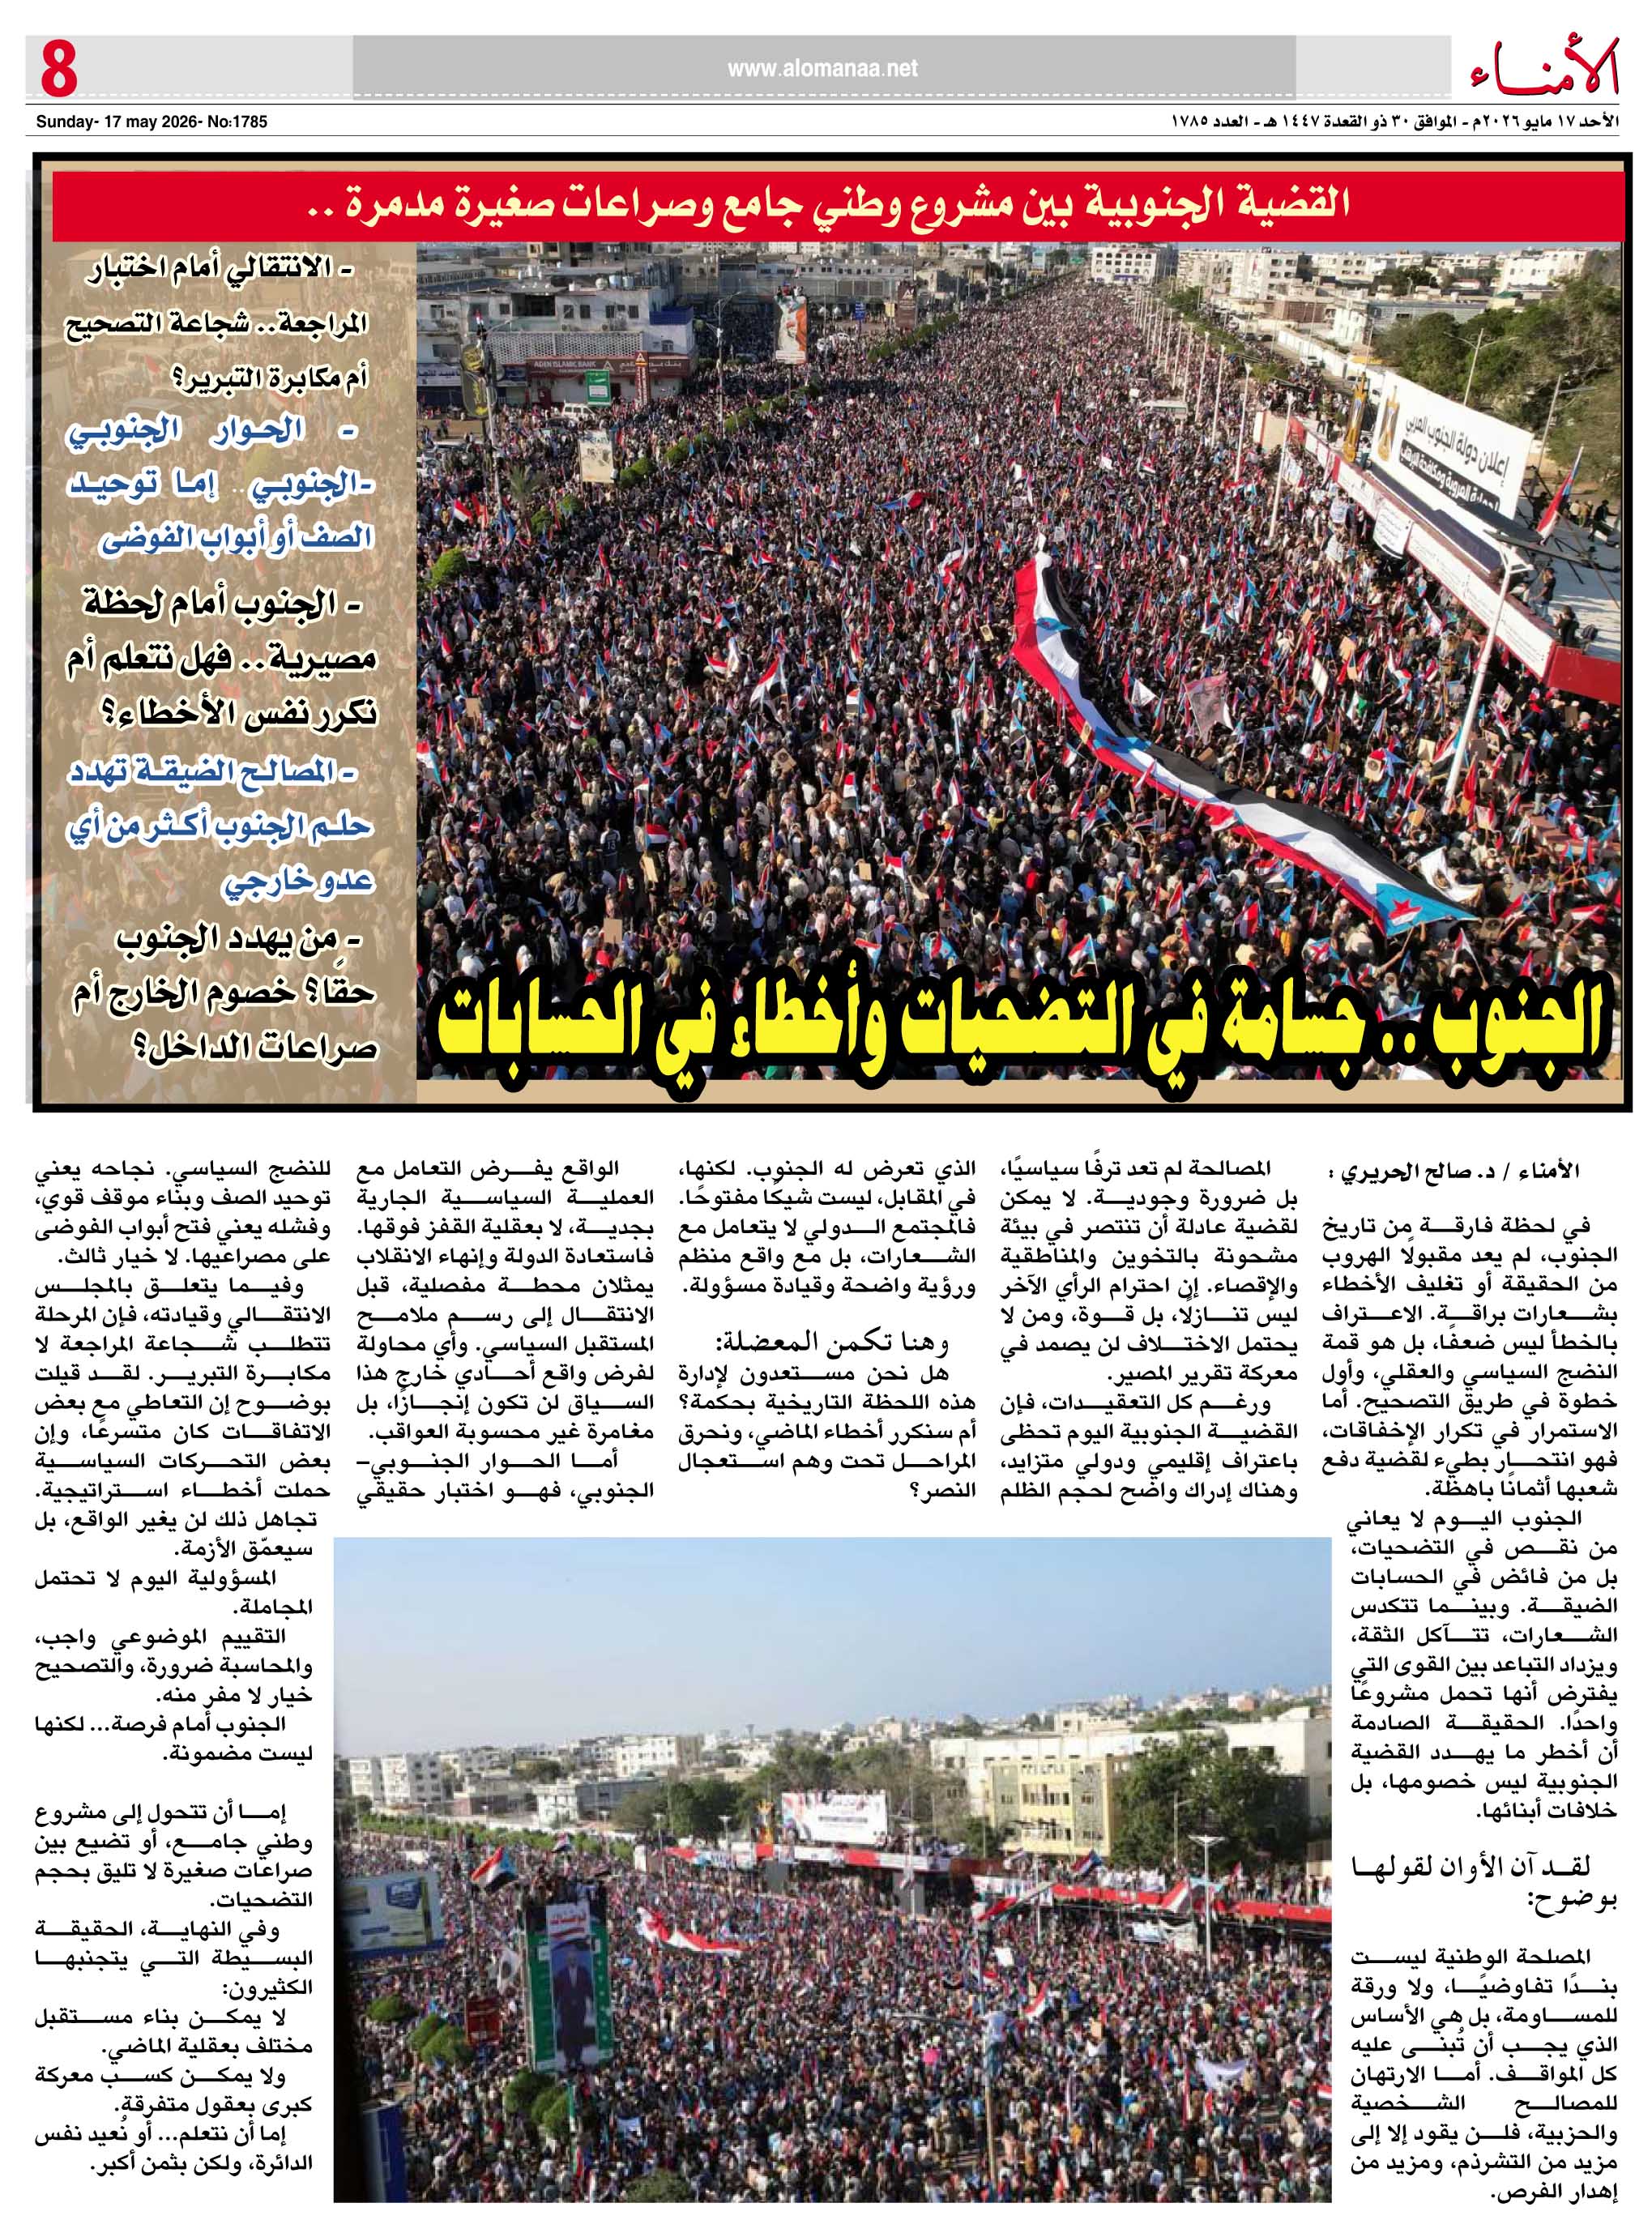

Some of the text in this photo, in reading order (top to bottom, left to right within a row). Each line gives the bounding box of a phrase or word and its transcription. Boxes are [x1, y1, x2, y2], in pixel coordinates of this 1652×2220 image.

[41, 38, 78, 98] 8
[728, 58, 919, 78] www.alomanaa.net
[1470, 31, 1620, 96] الأمناء
[105, 114, 122, 128] 17
[126, 117, 158, 132] may
[1172, 114, 1208, 127] ١٧٨٥
[1213, 114, 1249, 127] العدد
[1263, 117, 1278, 127] هـ
[1283, 113, 1320, 127] ١٤٤٧
[1324, 113, 1368, 128] القعدة
[1369, 113, 1388, 132] ذو
[1391, 114, 1408, 127] ٣٠
[1414, 113, 1457, 132] الموافق
[1522, 114, 1552, 132] مايو
[1558, 114, 1576, 127] ١٧
[1579, 110, 1620, 127] الأحد
[346, 185, 445, 228] مدمرة
[455, 184, 555, 228] صغيرة
[562, 183, 714, 228] وصراعات
[723, 185, 804, 234] جامع
[813, 183, 902, 233] وطني
[911, 182, 1014, 236] مشروع
[1022, 188, 1074, 228] بين
[1084, 183, 1223, 230] الجنوبية
[1236, 182, 1350, 228] القضية
[87, 255, 165, 288] اختبار
[173, 249, 218, 286] أمام
[227, 254, 331, 288] الانتقالي
[66, 311, 366, 343] المراجعة.. شجاعة التصحيح
[173, 361, 366, 396] أم مكابرة التبرير؟
[69, 415, 178, 450] الجنوبي
[214, 416, 301, 446] الحوار
[1406, 415, 1510, 487] إعلان دولة الجنوب العربي
[70, 469, 157, 501] توحيد
[176, 470, 216, 498] إما
[102, 518, 371, 557] الصف أو أبواب الفوضى
[83, 587, 164, 620] لحظة
[172, 581, 224, 624] أمام
[234, 588, 335, 625] الجنوب
[67, 636, 376, 680] مصيرية.. فهل نتعلم أم
[102, 691, 377, 733] نكرر نفس الأخطاء؟
[70, 758, 127, 788] تهدد
[135, 757, 233, 789] الضيقة
[241, 758, 333, 793] المصالح
[70, 806, 371, 846] حلم الجنوب أكثر من أي
[224, 867, 373, 902] عدو خارجي
[117, 922, 218, 960] الجنوب
[228, 927, 293, 958] يهدد
[299, 927, 337, 958] من
[74, 971, 100, 1013] أم
[109, 977, 198, 1017] الخارج
[207, 978, 297, 1013] خصوم
[438, 977, 643, 1078] الحسابات
[655, 980, 716, 1090] في
[731, 959, 887, 1078] وأخطاء
[901, 977, 1135, 1073] التضحيات
[1147, 978, 1208, 1089] في
[1222, 977, 1366, 1077] جسامة
[1432, 980, 1603, 1077] الجنوب
[134, 1031, 378, 1068] صراعات الداخل؟
[1341, 1161, 1419, 1186] الحريري
[1424, 1161, 1472, 1188] صالح
[1518, 1157, 1580, 1181] الأمناء
[35, 1187, 331, 1215] توحيد الصف وبناء موقف قوي،
[356, 1246, 654, 1270] فاستعادة الدولة وإنهاء الانقلاب
[1000, 1246, 1298, 1270] مشحونة بالتخوين والمناطقية
[1322, 1270, 1618, 1298] من الحقيقة أو تغليف الأخطاء
[716, 1326, 949, 1360] وهنا تكمن المعضلة:
[679, 1393, 976, 1417] هذه اللحظة التاريخية بحكمة؟
[1000, 1480, 1298, 1506] وهناك إدراك واضح لحجم الظلم
[1351, 1850, 1590, 1885] لقد آن الأوان لقولها
[1528, 1889, 1617, 1919] بوضوح:
[90, 2149, 313, 2177] الدائرة، ولكن بثمن أكبر.
[1491, 2181, 1619, 2205] إهدار الفرص.
